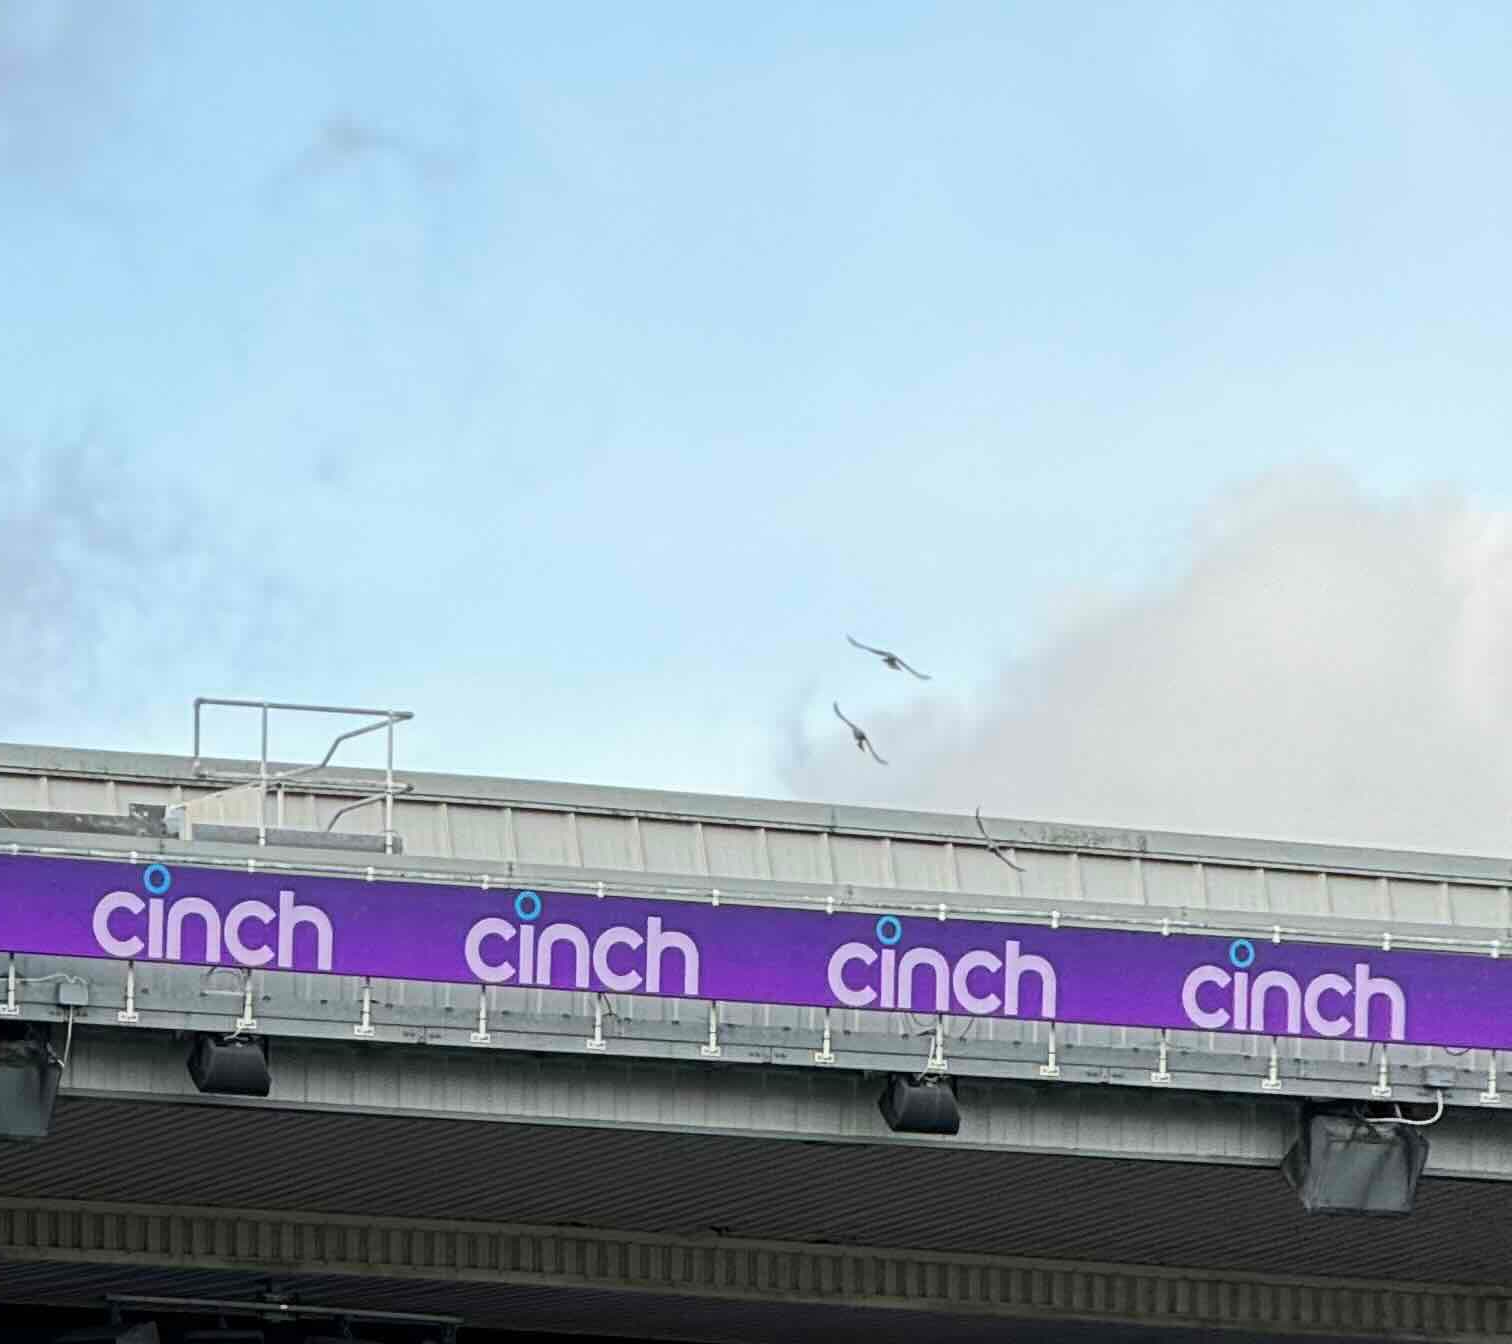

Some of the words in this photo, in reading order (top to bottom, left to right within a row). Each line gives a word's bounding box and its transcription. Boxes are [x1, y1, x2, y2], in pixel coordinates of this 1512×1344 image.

[93, 864, 333, 971] cinch
[465, 891, 699, 996] cinch
[828, 916, 1057, 1019] cinch
[1182, 939, 1406, 1041] cinch
